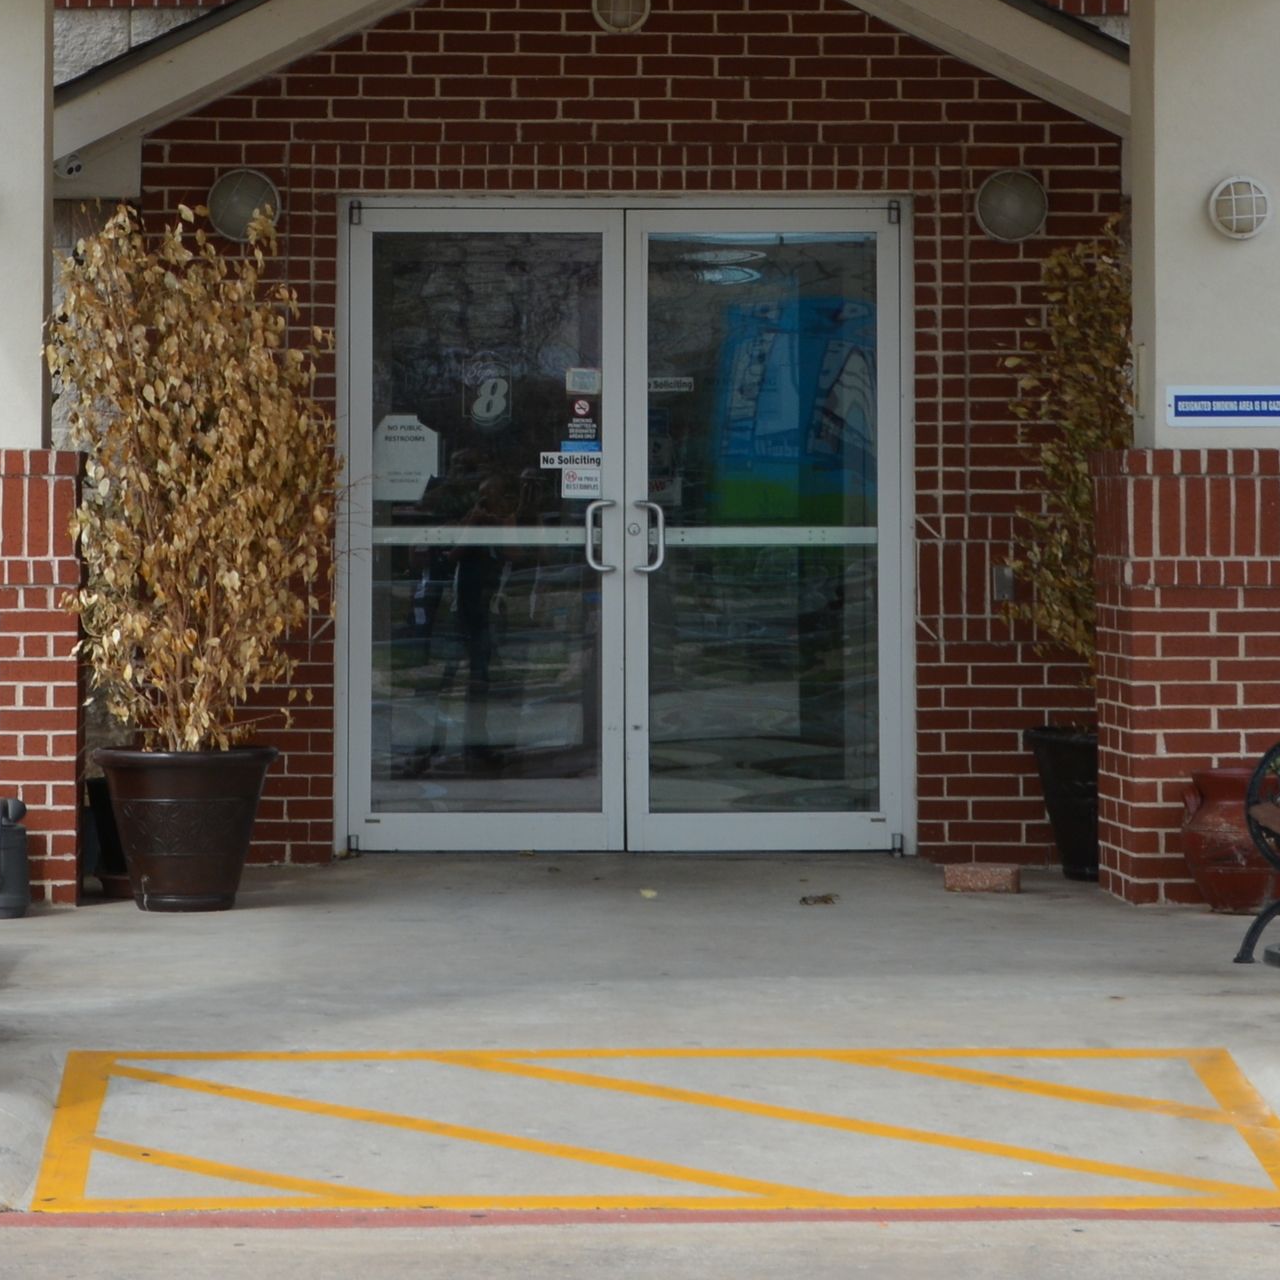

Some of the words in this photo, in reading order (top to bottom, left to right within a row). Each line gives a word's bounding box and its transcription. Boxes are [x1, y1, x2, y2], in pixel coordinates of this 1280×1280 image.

[473, 378, 508, 418] 8
[1239, 401, 1253, 411] AREA
[542, 455, 554, 465] No
[558, 455, 601, 467] Soliciting
